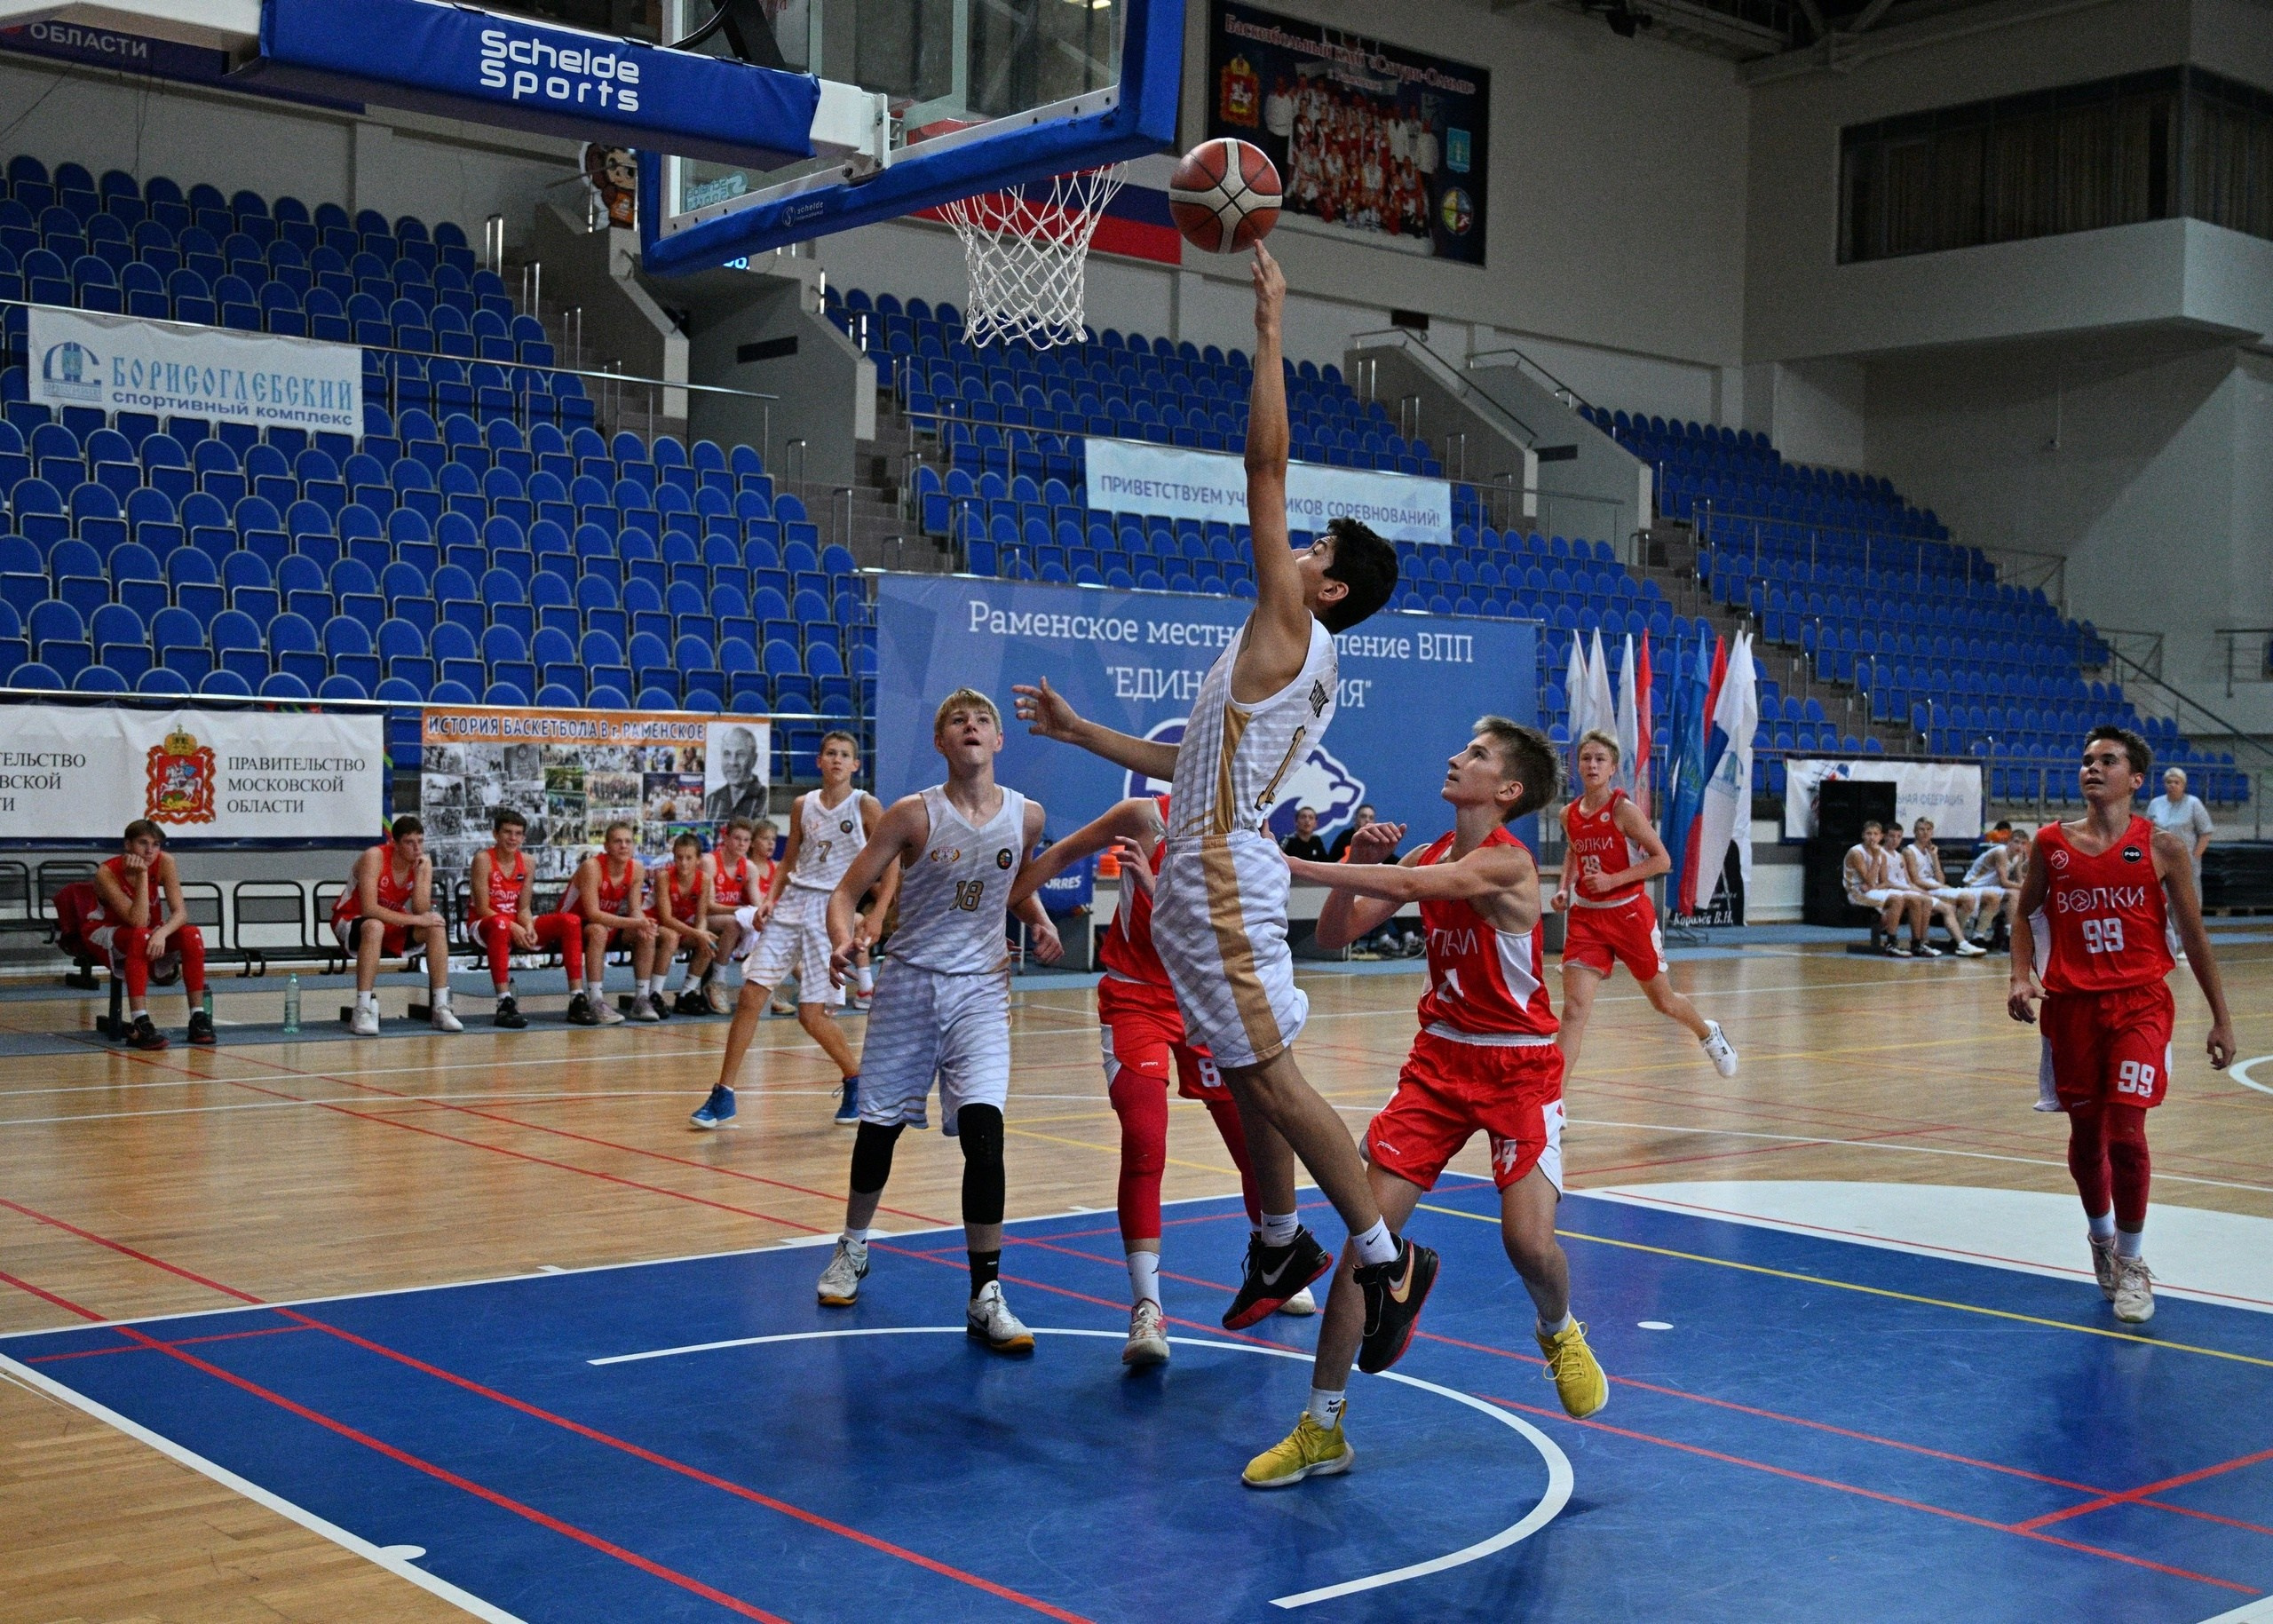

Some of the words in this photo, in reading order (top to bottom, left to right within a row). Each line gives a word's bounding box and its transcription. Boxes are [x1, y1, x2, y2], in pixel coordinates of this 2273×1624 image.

[30, 23, 147, 59] ОБЛАСТИ
[481, 29, 639, 84] Schelde
[480, 59, 639, 112] Sports
[112, 356, 353, 411] БОРИСОГЛЕБСКИЙ
[113, 390, 249, 416] спортивный
[257, 405, 353, 426] комплекс
[1101, 474, 1223, 505] ПРИВЕТСТВУЕМ
[1327, 499, 1440, 527] СОРЕВНОВАНИЙ!
[969, 599, 1138, 643] Раменское
[1146, 621, 1240, 648] местн
[1332, 633, 1410, 659] ление
[1417, 631, 1473, 662] ВПП
[1106, 666, 1202, 701] "ЕДИН
[1335, 678, 1372, 708] ИЯ"
[428, 716, 499, 736] ИСТОРИЯ
[503, 717, 597, 740] БАСКЕТБОЛА
[622, 721, 704, 741] РАМЕНСКОЕ
[228, 757, 366, 772] ПРАВИТЕЛЬСТВО
[1255, 725, 1306, 812] 1
[228, 776, 345, 793] МОСКОВСКОЙ
[227, 799, 305, 814] ОБЛАСТИ
[818, 840, 832, 862] 7
[1574, 836, 1613, 853] ОЛКИ
[949, 880, 985, 912] 18
[1044, 875, 1082, 891] ORRES
[2057, 885, 2145, 914] ВОЛКИ
[2082, 917, 2124, 954] 99
[1198, 1057, 1223, 1088] 8
[2118, 1060, 2156, 1097] 99
